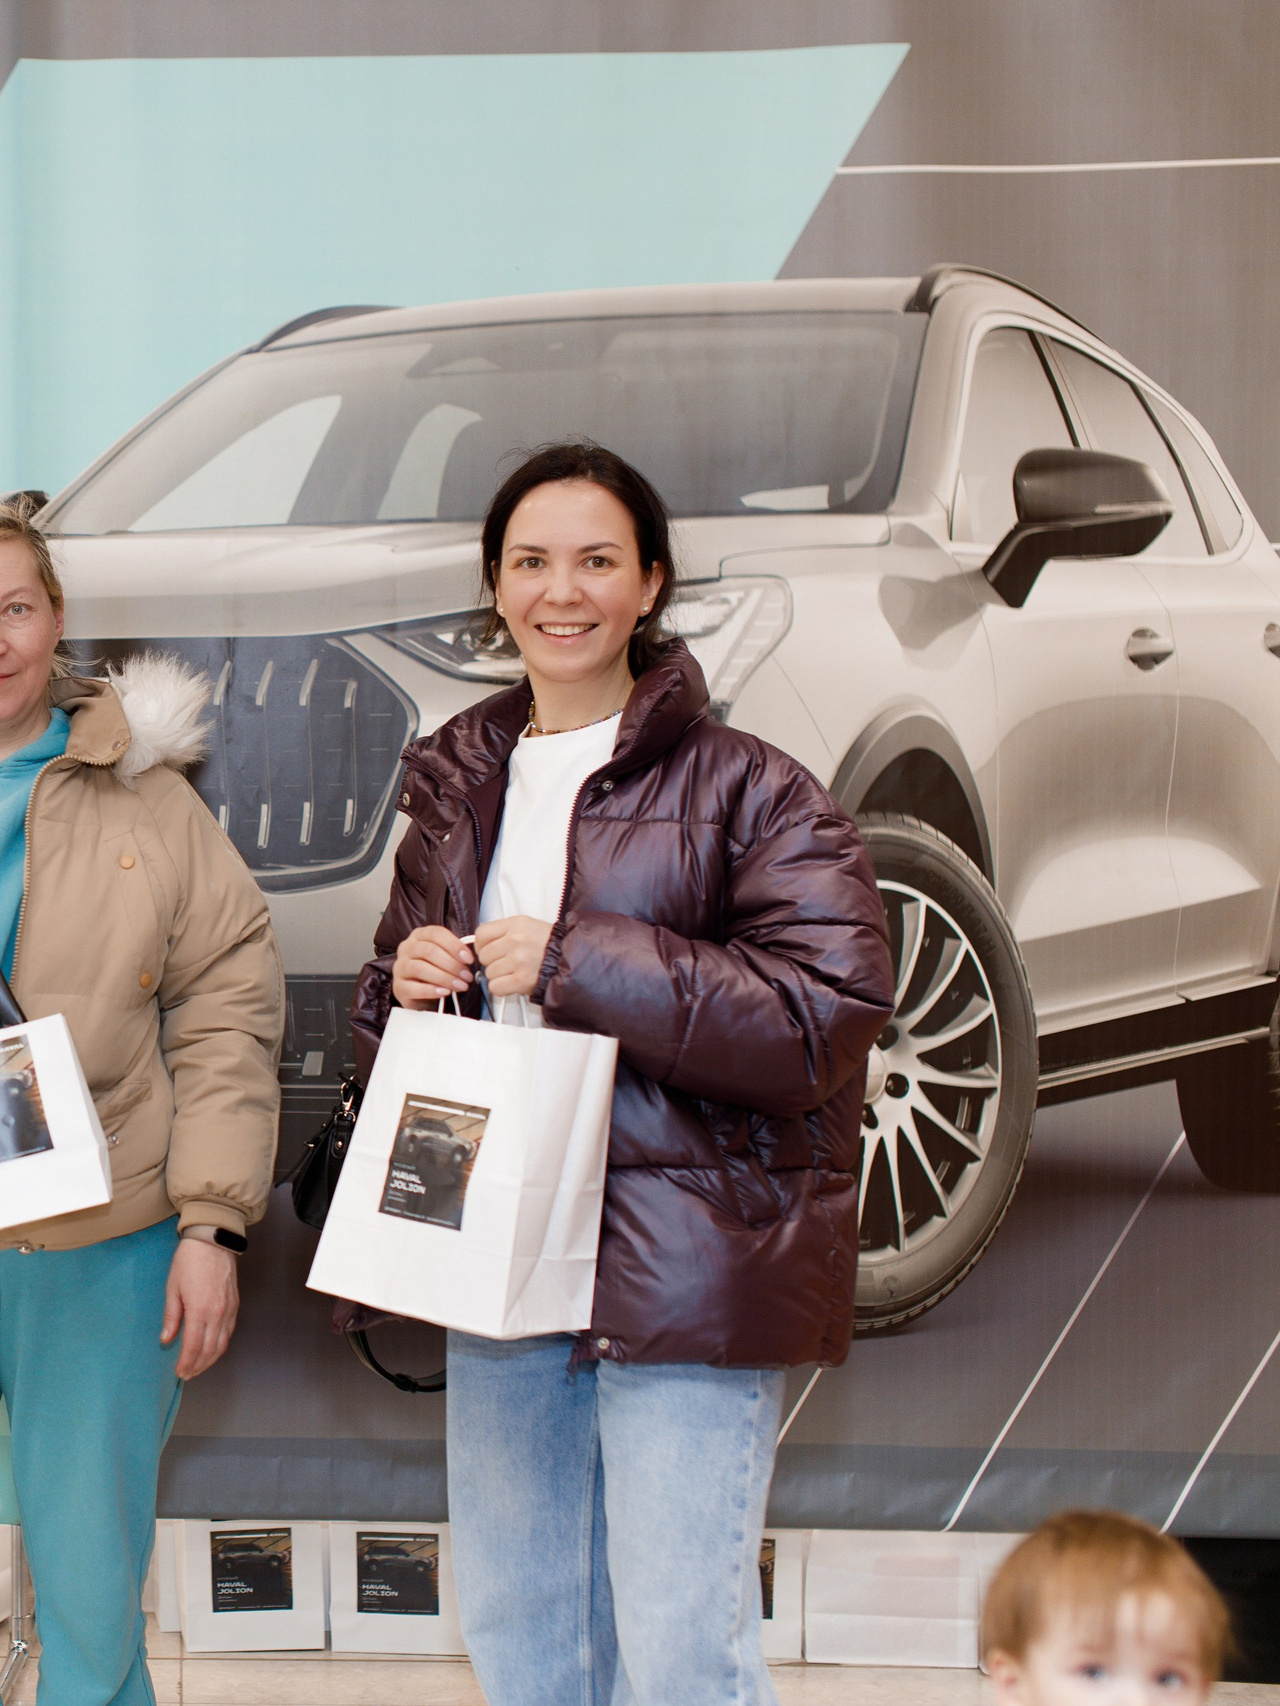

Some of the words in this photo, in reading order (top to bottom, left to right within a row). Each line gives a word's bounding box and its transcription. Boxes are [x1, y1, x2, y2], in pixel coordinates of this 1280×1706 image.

[391, 1169, 422, 1184] HAVAL
[389, 1179, 426, 1195] JOLION
[217, 1587, 254, 1595] JOLION
